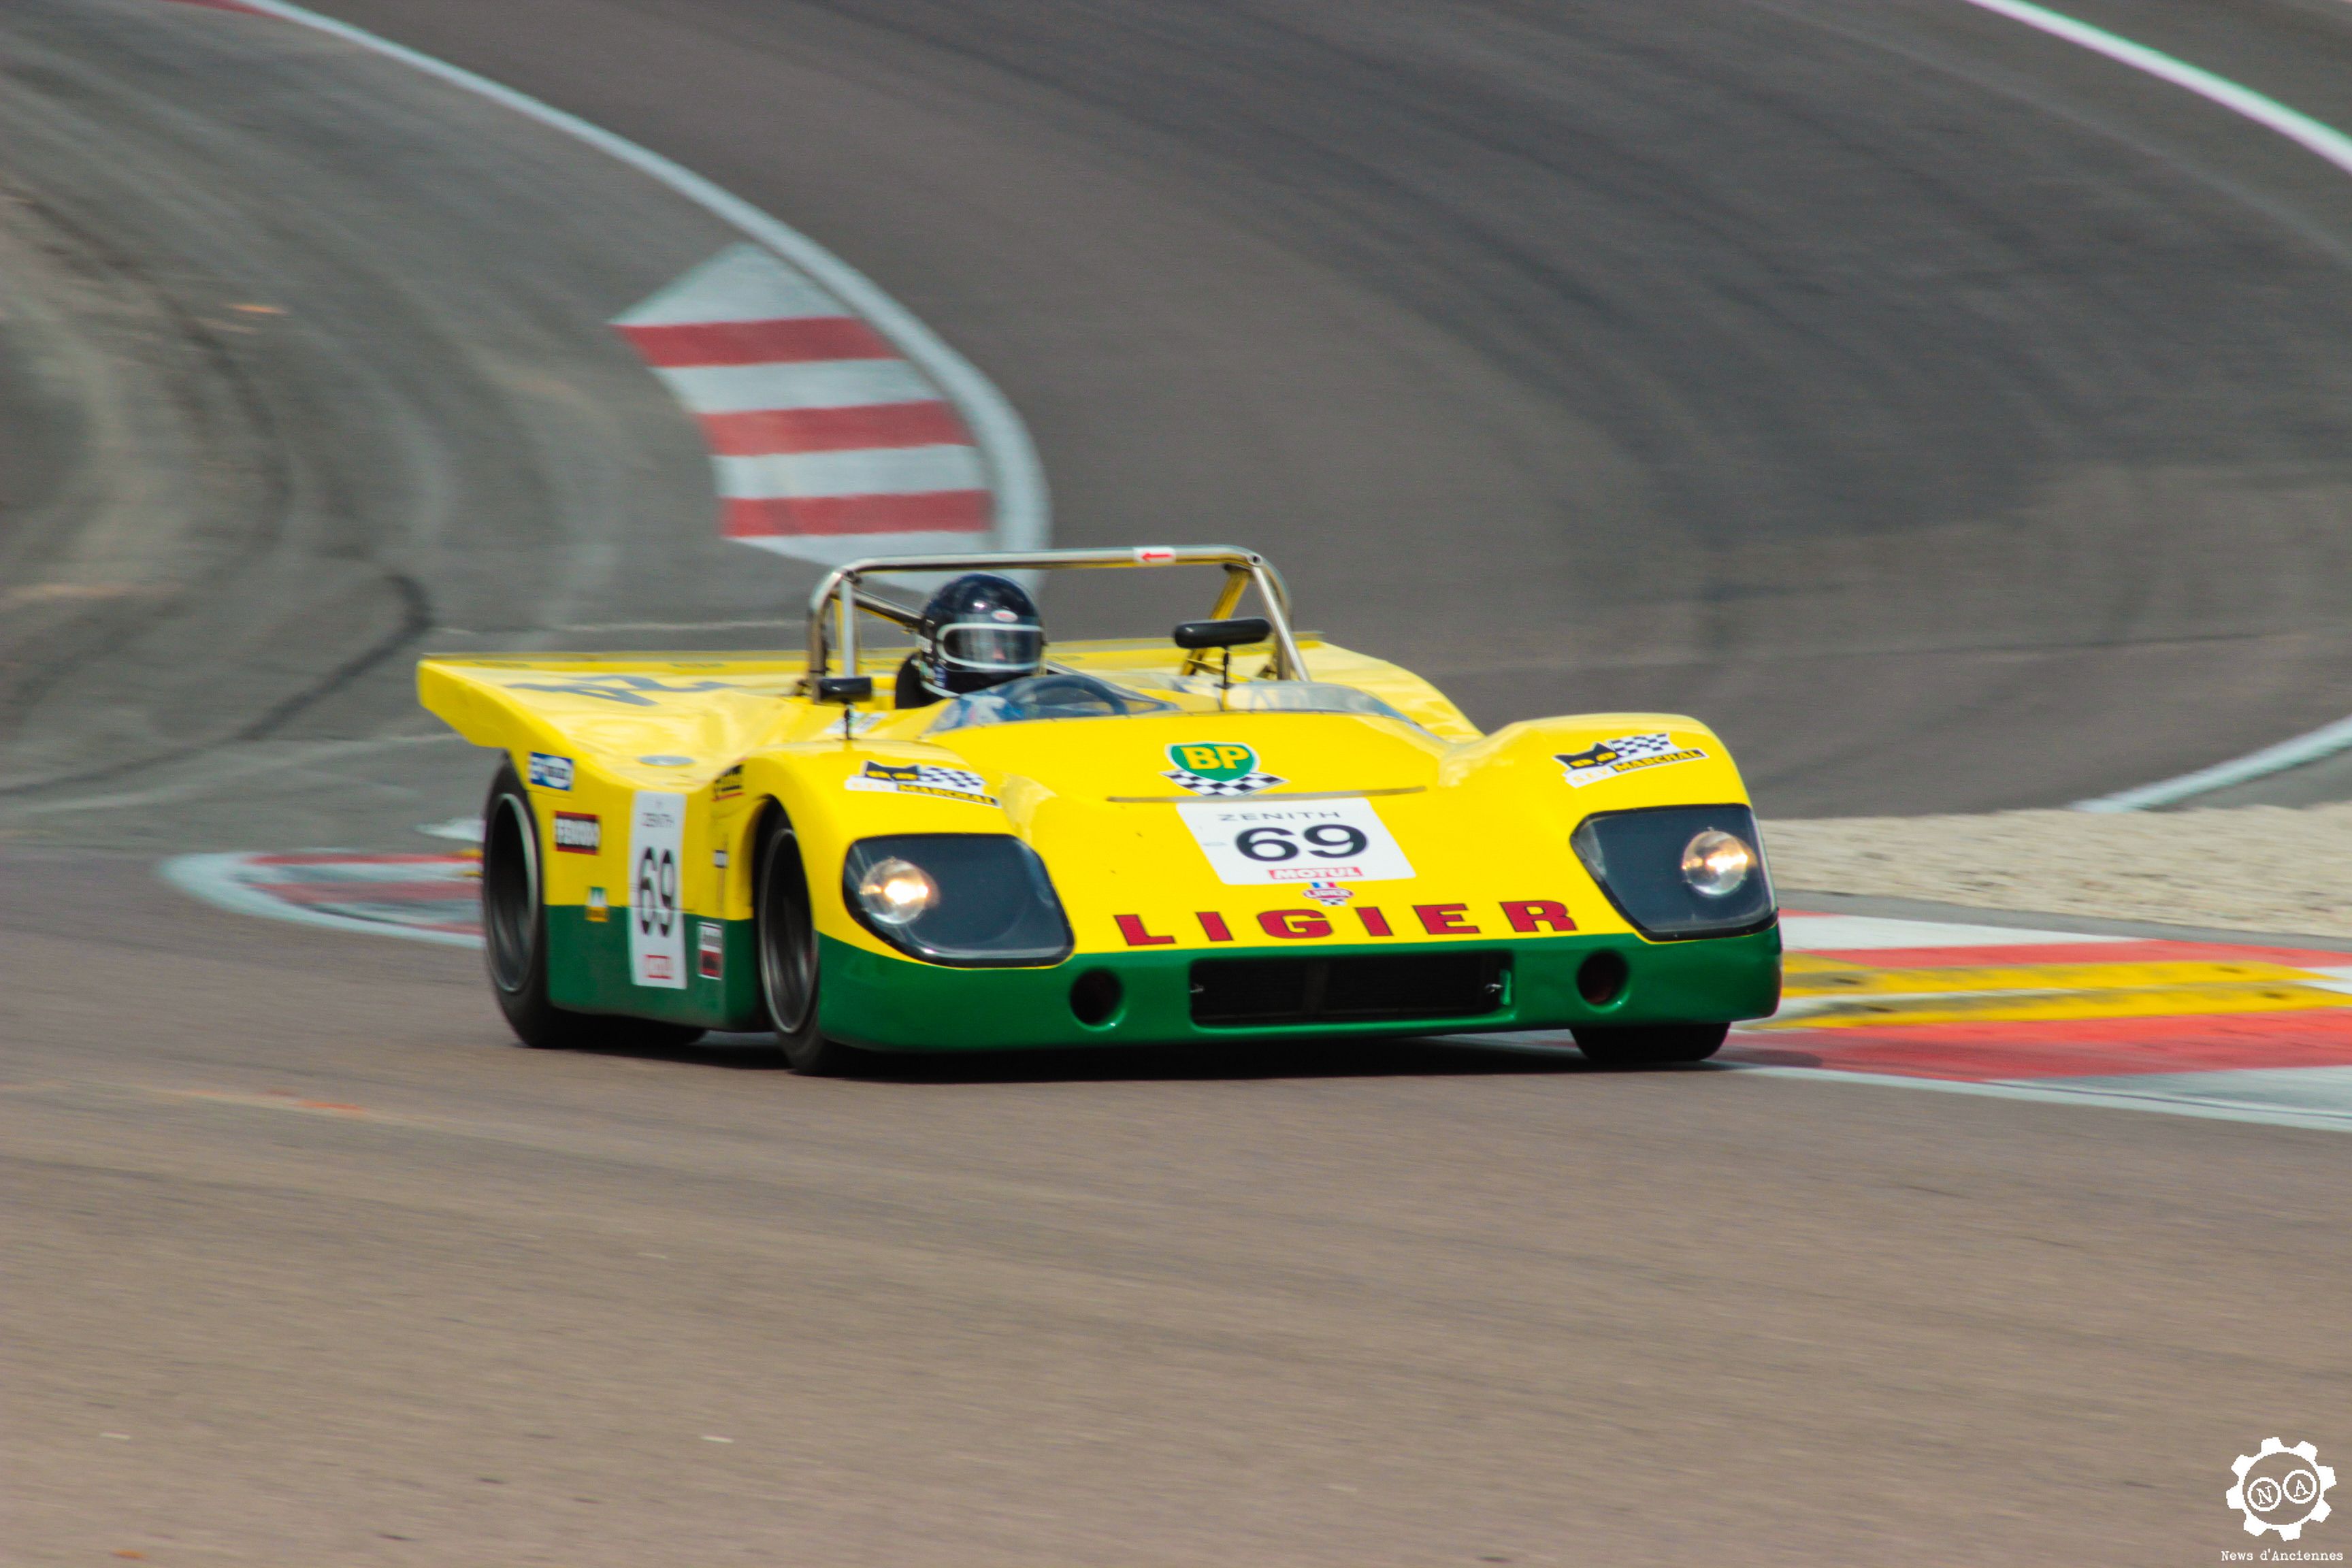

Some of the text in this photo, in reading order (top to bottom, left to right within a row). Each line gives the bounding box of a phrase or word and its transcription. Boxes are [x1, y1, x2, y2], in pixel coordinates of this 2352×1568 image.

[1179, 745, 1250, 769] BP
[1612, 750, 1702, 772] MARCHAL
[1218, 811, 1341, 821] ZENITH
[1235, 823, 1368, 862] 69
[1275, 868, 1357, 879] MOTUL
[638, 847, 675, 938] 69
[1113, 900, 1578, 946] LIGIER
